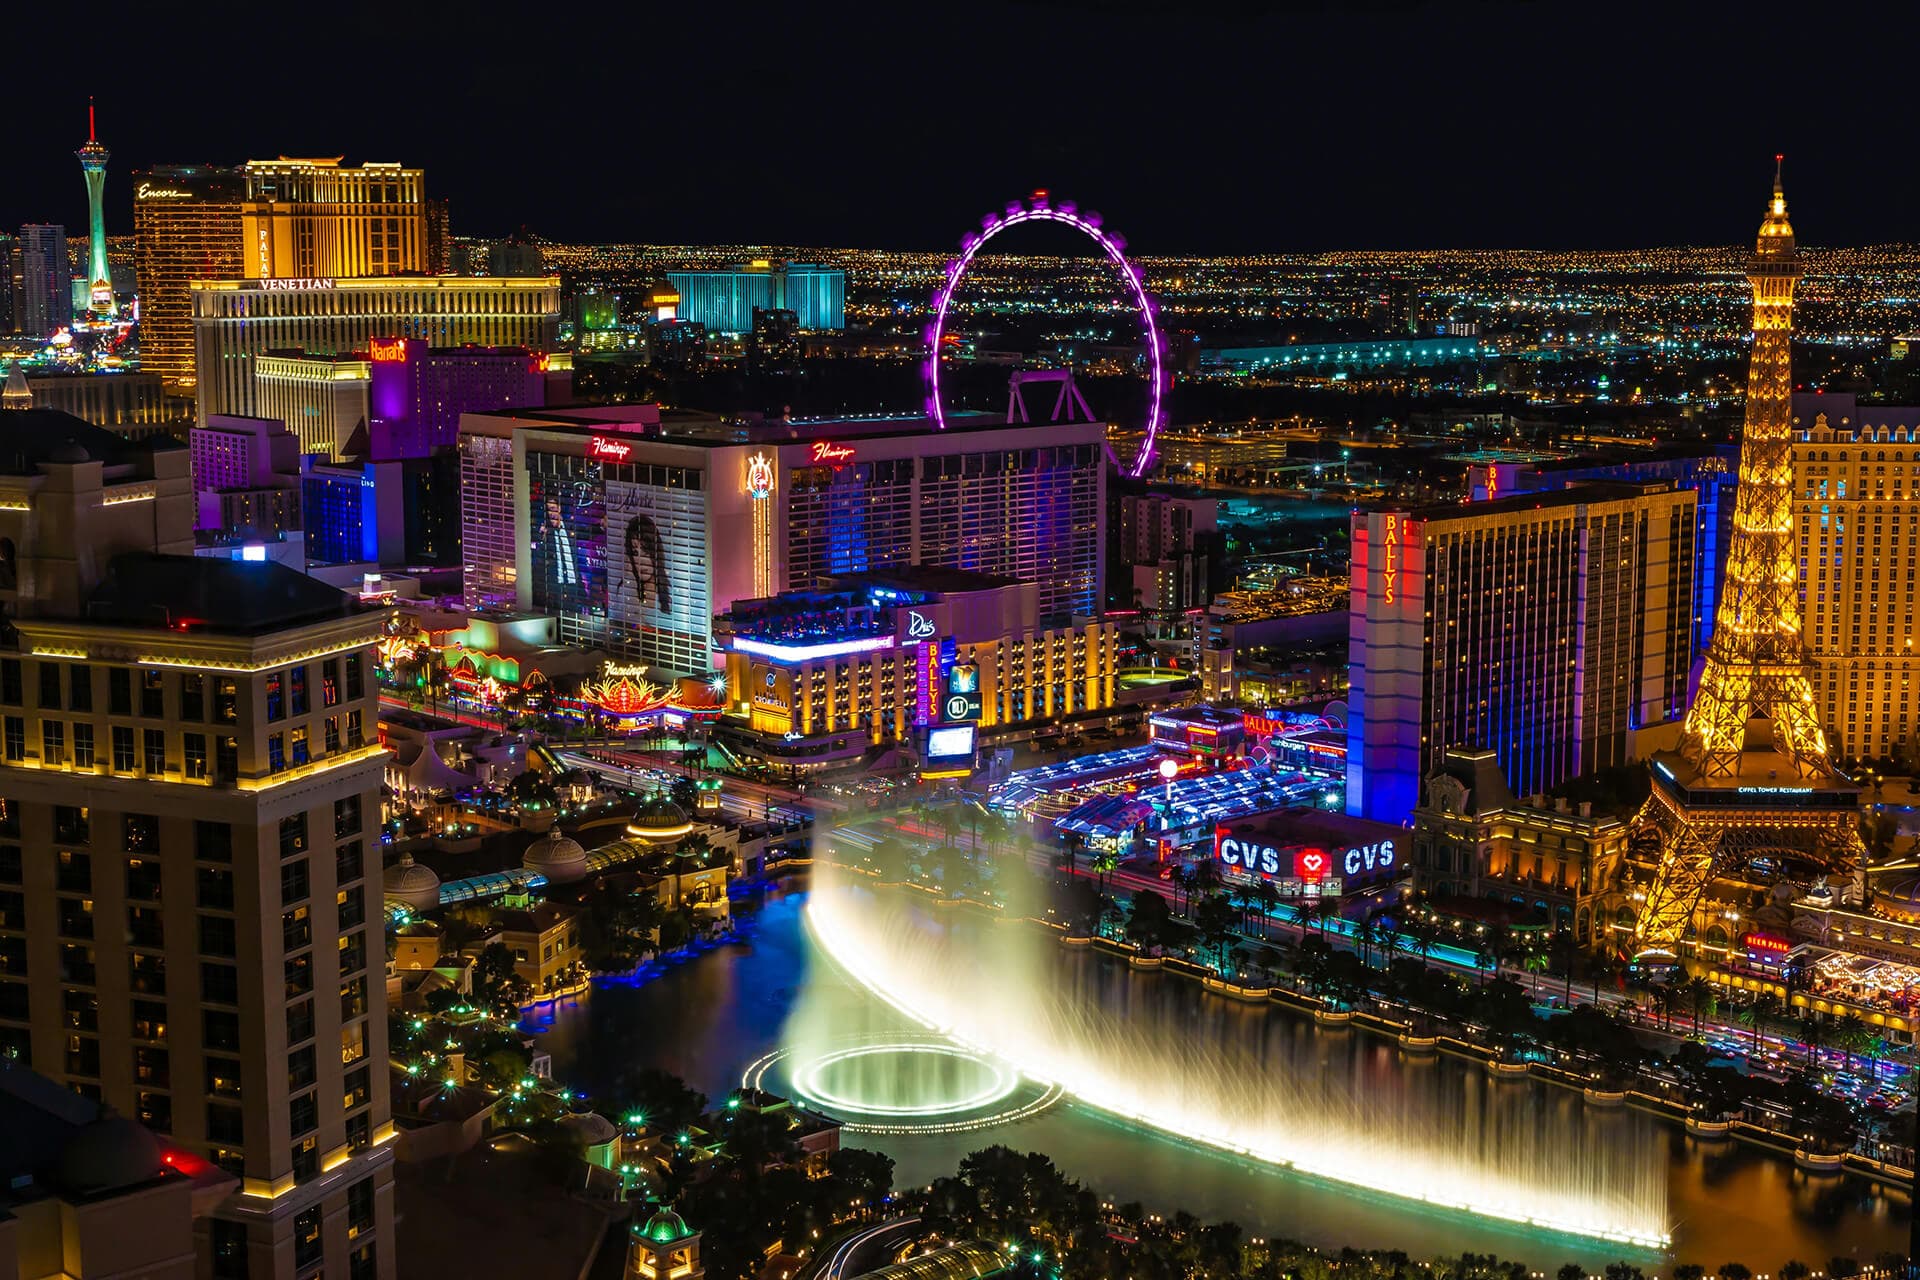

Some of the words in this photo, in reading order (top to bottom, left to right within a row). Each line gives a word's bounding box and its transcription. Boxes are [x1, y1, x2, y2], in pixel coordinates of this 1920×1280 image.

[138, 183, 192, 199] Encore
[260, 278, 332, 290] VENETIAN
[592, 437, 630, 459] Flamingo
[1383, 515, 1397, 604] BALLYS
[604, 660, 649, 679] Flamingo
[929, 644, 938, 715] BALLYS
[1220, 838, 1279, 875] CVS
[1344, 840, 1394, 875] CVS
[1747, 936, 1766, 947] BEER
[1768, 940, 1789, 952] PARK
